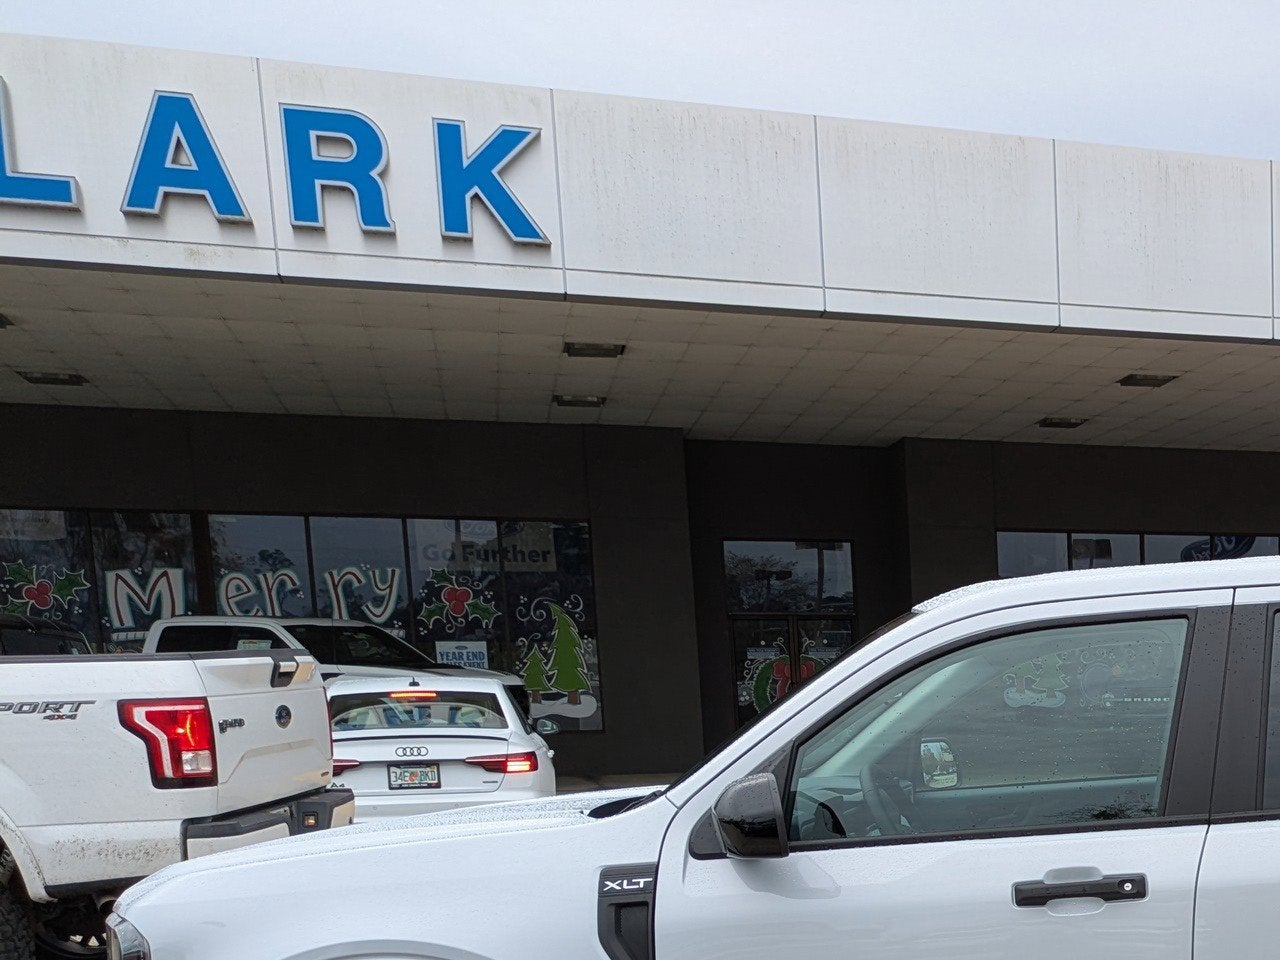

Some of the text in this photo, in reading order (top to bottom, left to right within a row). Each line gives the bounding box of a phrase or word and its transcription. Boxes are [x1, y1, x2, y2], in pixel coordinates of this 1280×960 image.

[0, 76, 552, 246] LARK
[422, 544, 550, 563] Go Further
[105, 567, 399, 627] Merry
[439, 651, 485, 661] YEAR END
[603, 878, 653, 891] XLT
